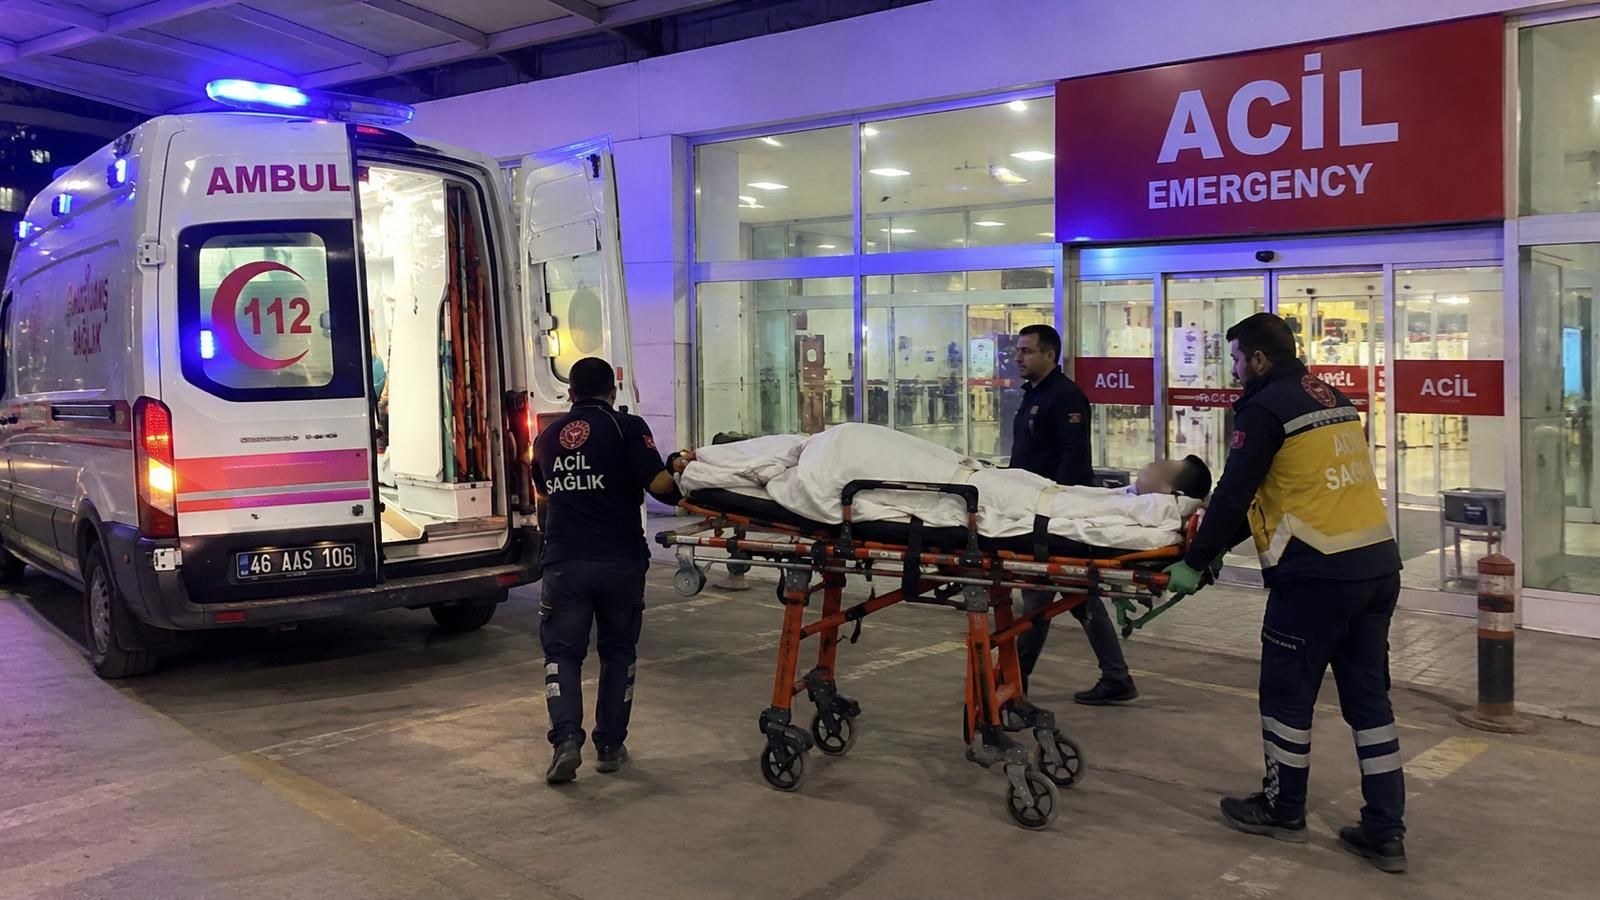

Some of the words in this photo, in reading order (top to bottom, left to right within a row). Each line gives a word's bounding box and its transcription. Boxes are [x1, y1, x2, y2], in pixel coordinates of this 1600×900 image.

[1157, 52, 1399, 163] ACİL
[206, 164, 351, 196] AMBUL
[1148, 162, 1374, 210] EMERGENCY
[244, 297, 312, 335] 112
[1094, 369, 1136, 389] ACİL
[1420, 373, 1477, 397] ACİL
[553, 451, 591, 473] ACİL
[546, 472, 606, 495] SAĞLIK
[250, 553, 272, 574] 46
[281, 550, 313, 572] AAS
[322, 547, 353, 568] 106
